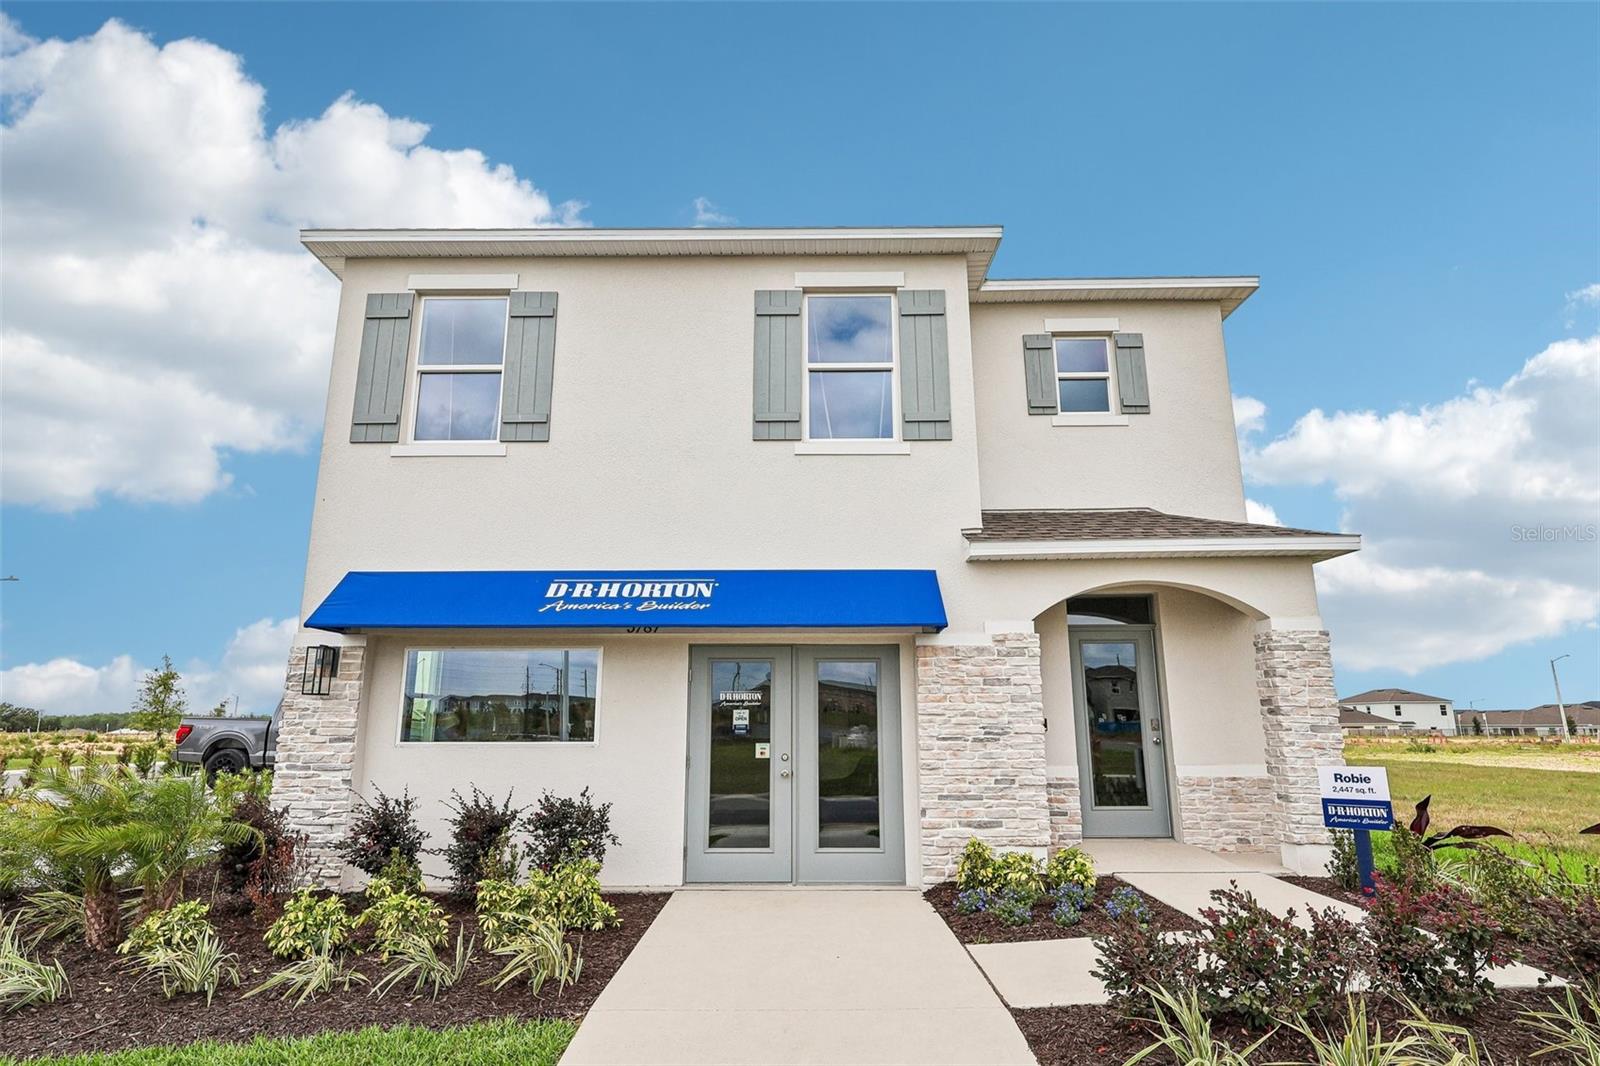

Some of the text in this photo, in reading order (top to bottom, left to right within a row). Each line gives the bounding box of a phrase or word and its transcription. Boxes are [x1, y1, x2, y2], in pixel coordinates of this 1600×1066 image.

[538, 600, 711, 612] America's Builder
[1333, 773, 1371, 784] Robie
